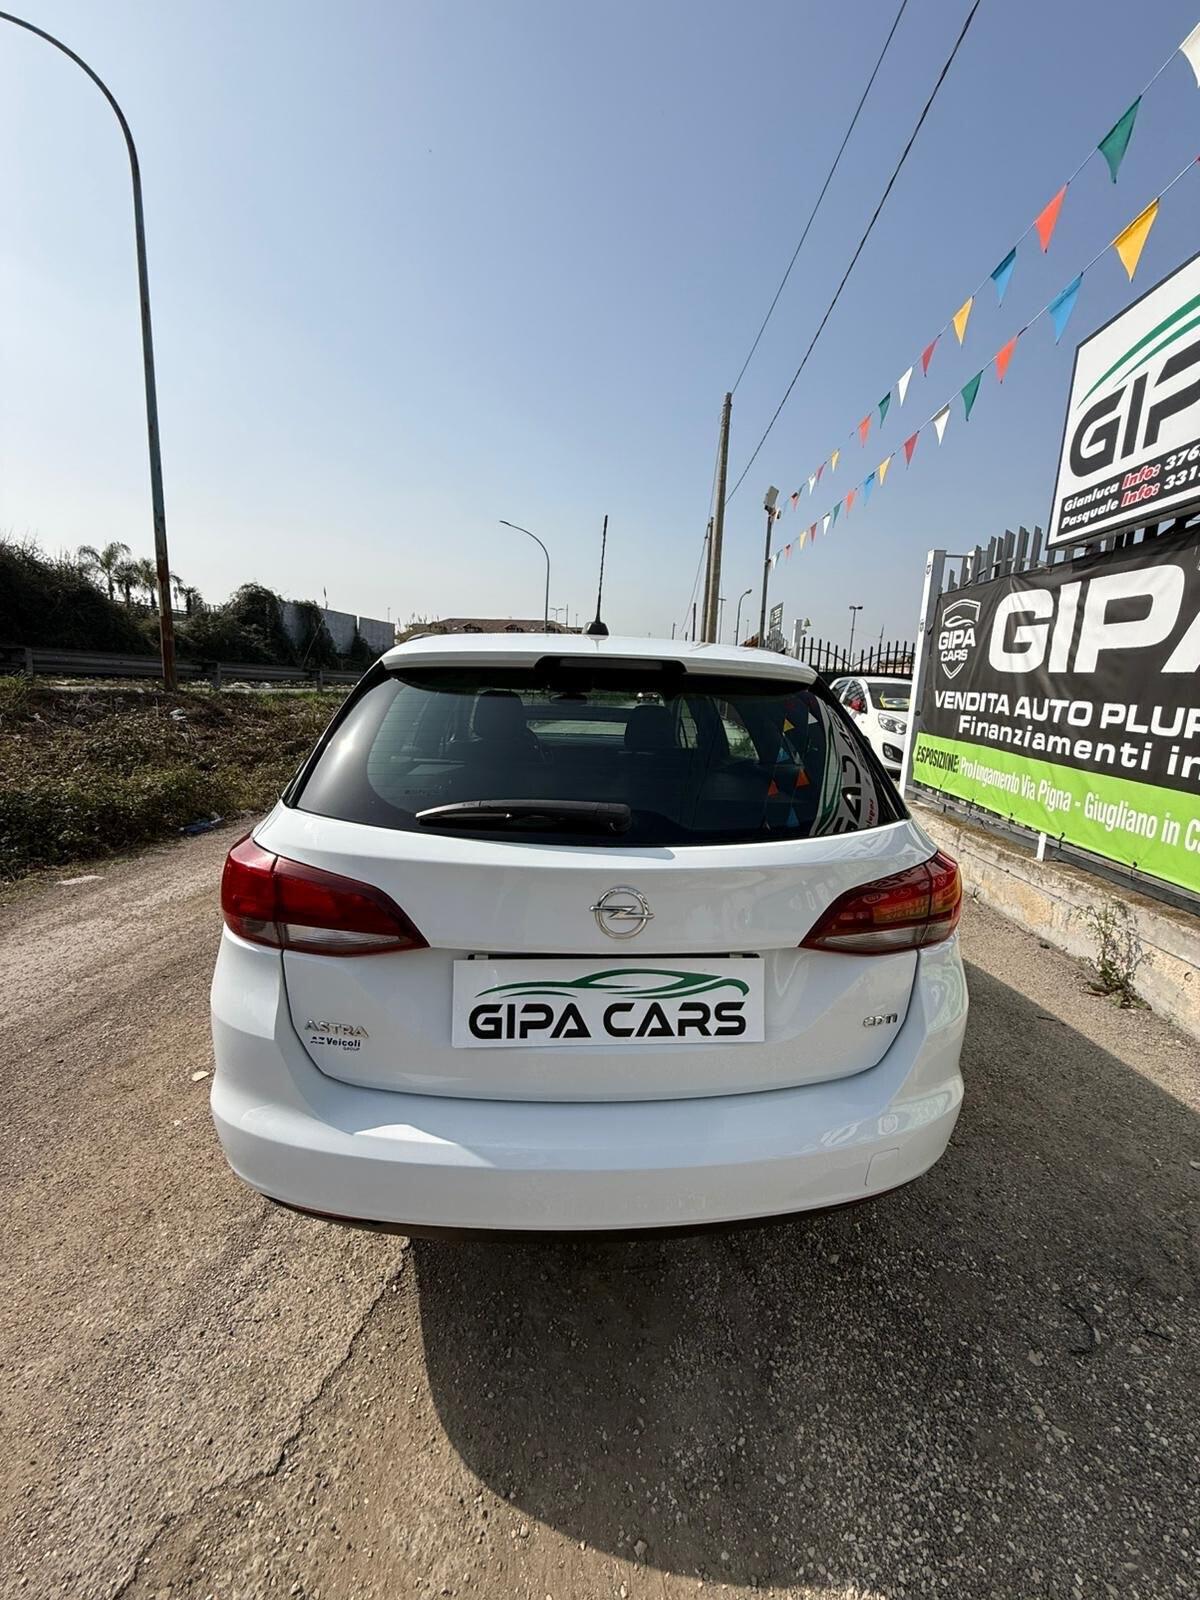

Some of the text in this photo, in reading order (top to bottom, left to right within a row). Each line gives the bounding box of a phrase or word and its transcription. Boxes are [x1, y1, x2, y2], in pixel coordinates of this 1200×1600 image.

[1060, 465, 1200, 529] Pasquale Info: 331
[1064, 444, 1200, 512] Gianluca Info: 376
[938, 628, 976, 650] GIPA
[940, 648, 969, 662] CARS
[935, 690, 1010, 716] VENDITA
[1014, 697, 1093, 727] AUTO
[958, 715, 1153, 771] Finanziamenti
[916, 745, 960, 774] ESPOSIZIONE:
[1021, 774, 1036, 801] Via
[1037, 779, 1072, 812] Pigna
[1084, 792, 1158, 839] Giugliano
[1161, 812, 1181, 847] in
[1184, 818, 1200, 854] C
[304, 1020, 368, 1037] ASTRA
[468, 1001, 747, 1040] GIPA CARS
[326, 1037, 361, 1047] Veicoli
